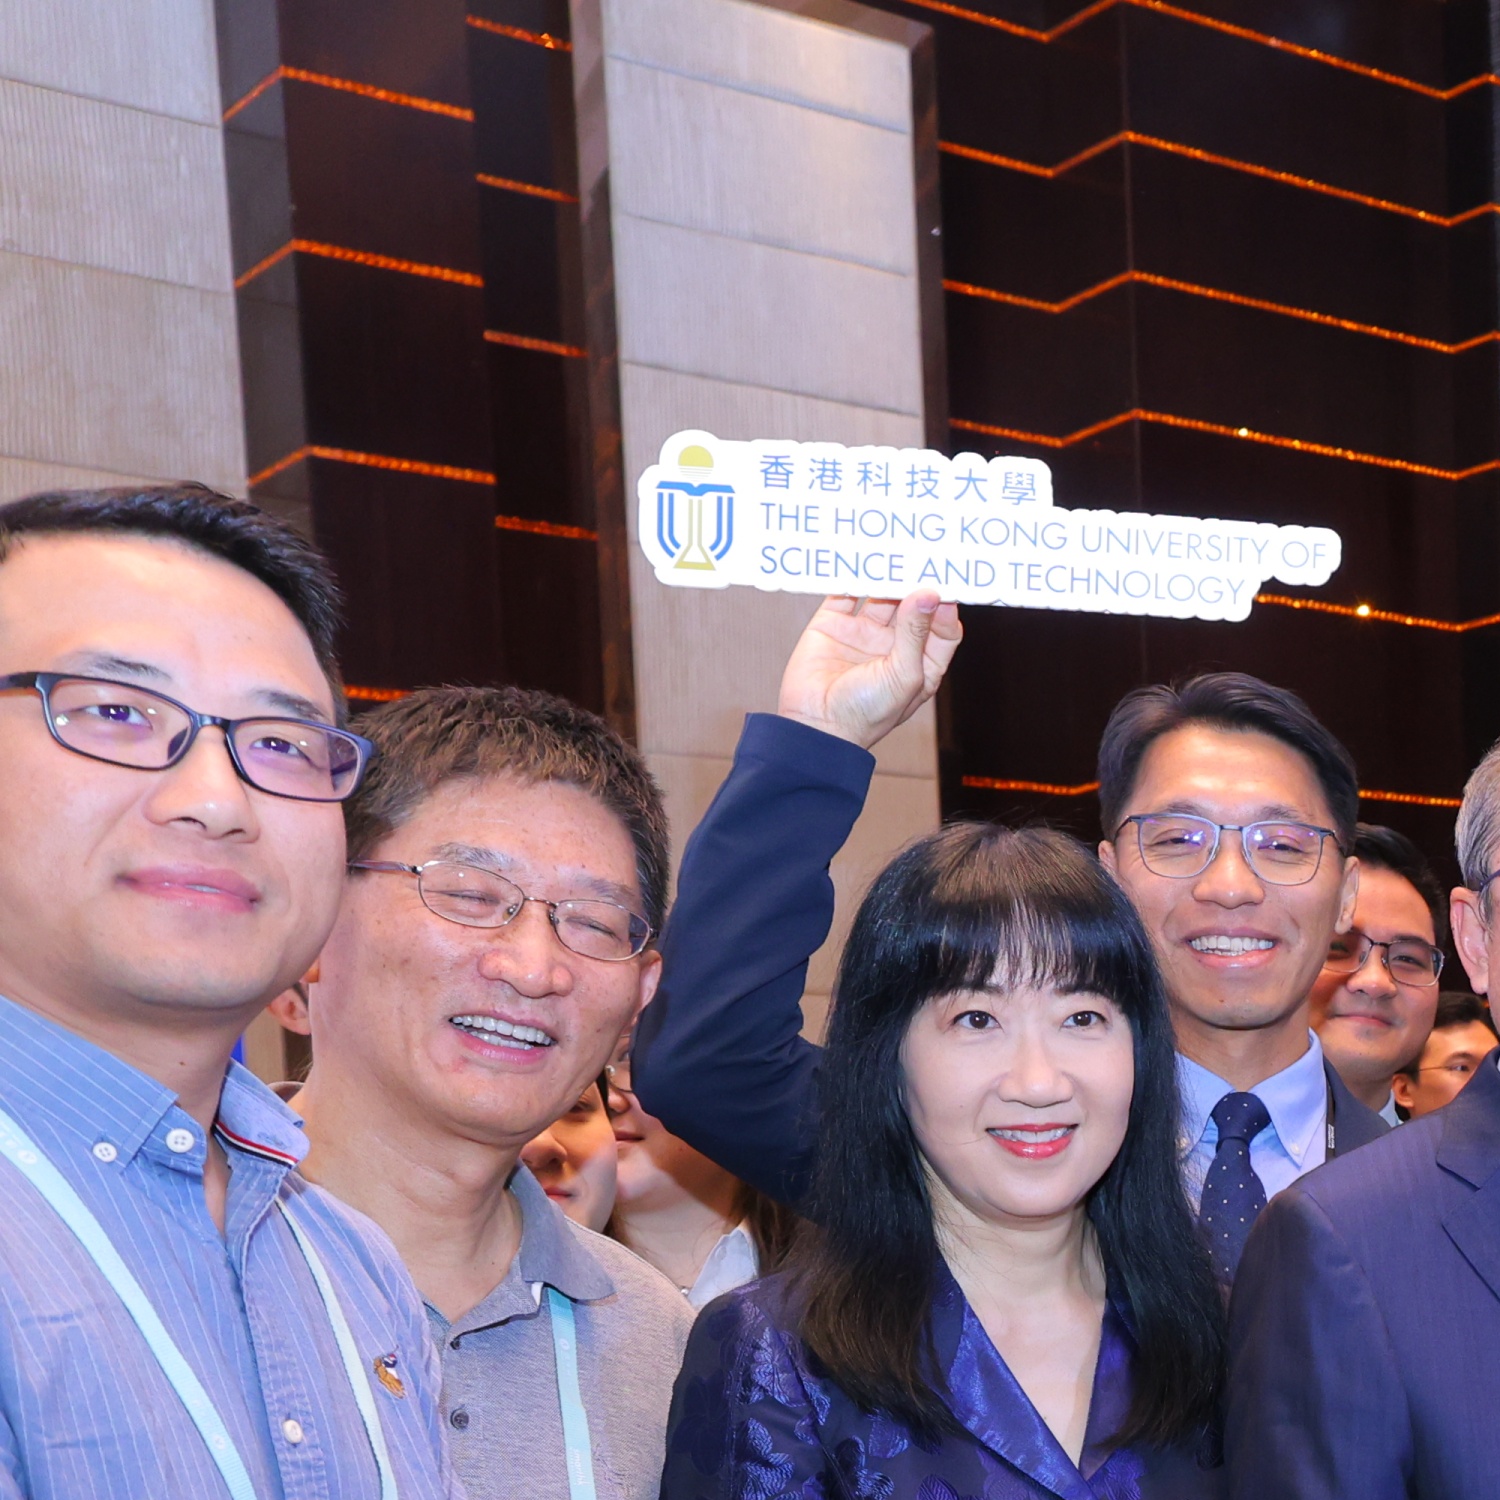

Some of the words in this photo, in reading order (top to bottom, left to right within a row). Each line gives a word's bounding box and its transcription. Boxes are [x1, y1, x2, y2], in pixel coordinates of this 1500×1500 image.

[757, 453, 1038, 507] 香港科技大學
[759, 502, 821, 535] THE
[834, 507, 946, 543] HONG
[960, 515, 1068, 552] KONG
[1081, 524, 1271, 567] UNIVERSITY
[1281, 540, 1328, 571] OF
[760, 545, 905, 582] SCIENCE
[917, 557, 997, 590] AND
[1009, 562, 1246, 606] TECHNOLOGY
